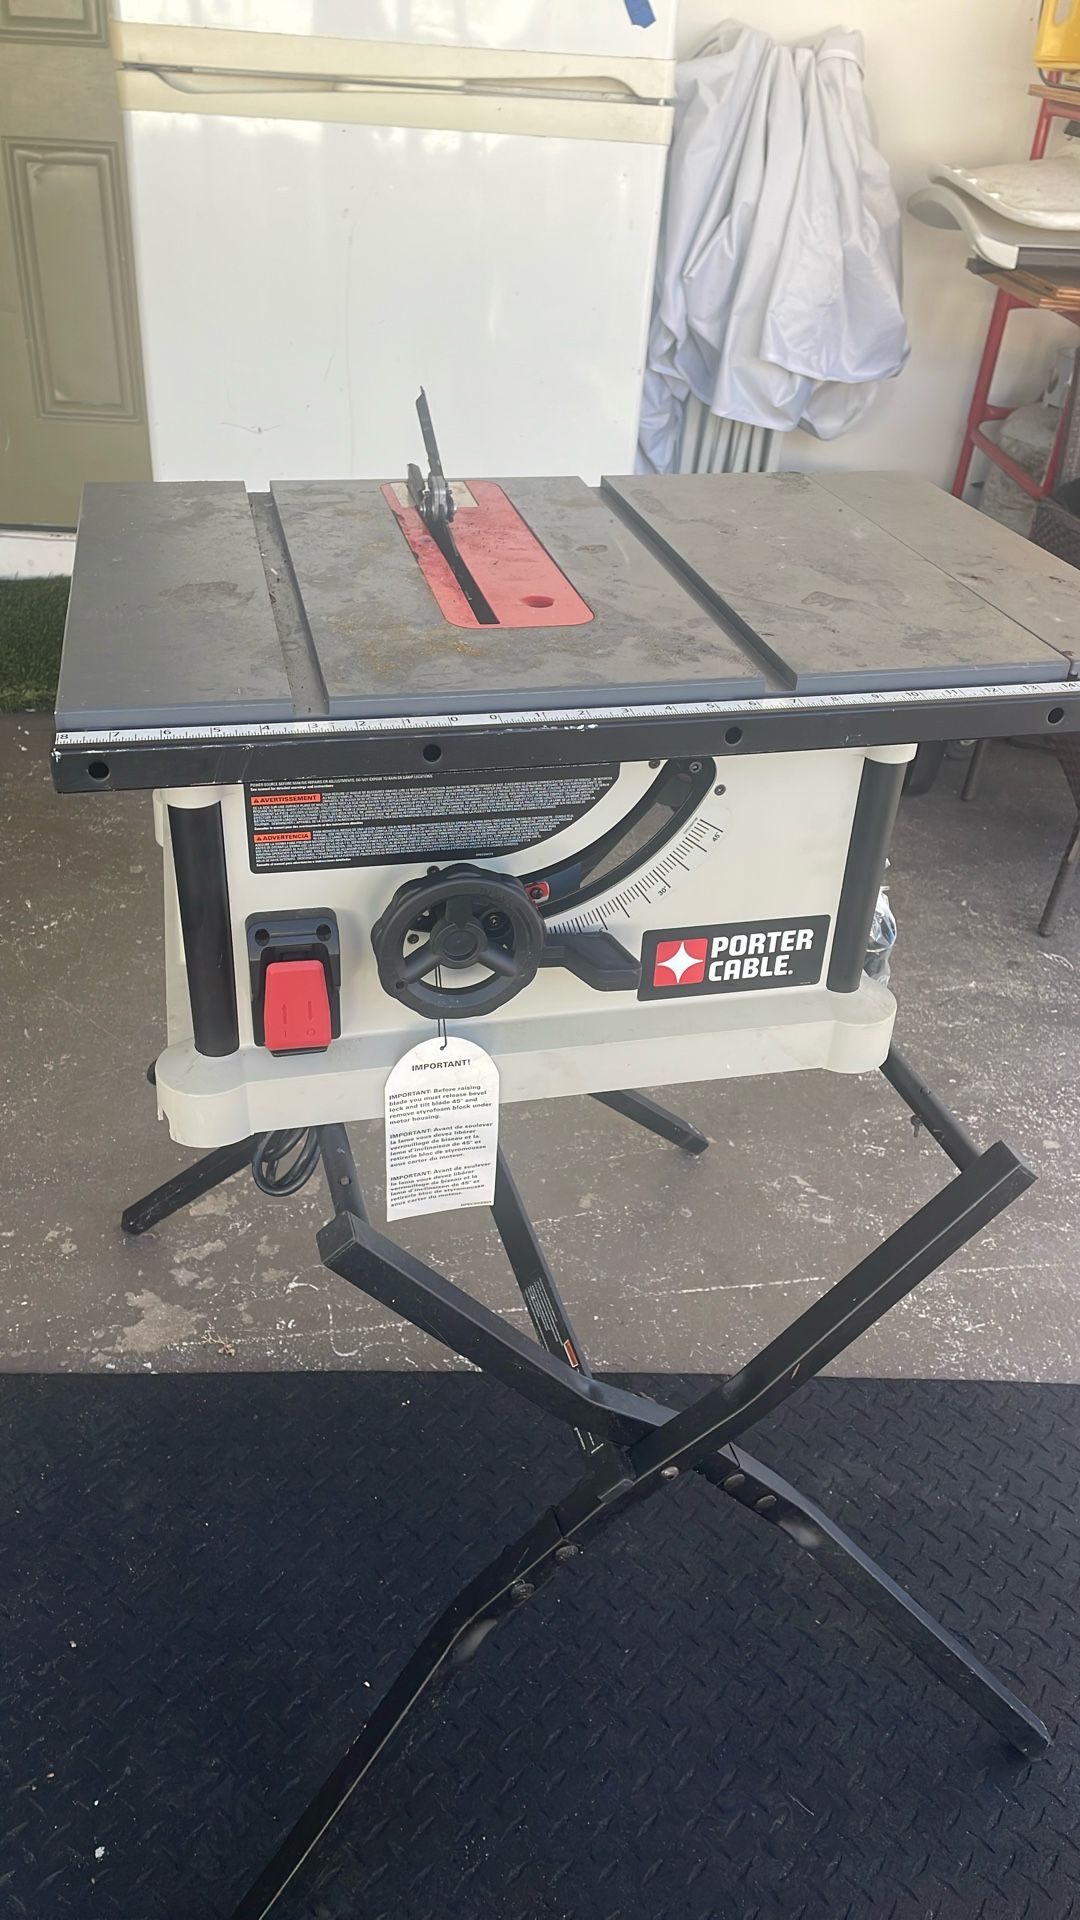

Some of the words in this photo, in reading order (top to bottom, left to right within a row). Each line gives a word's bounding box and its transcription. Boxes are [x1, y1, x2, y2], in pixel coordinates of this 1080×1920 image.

[658, 886, 667, 896] 30°
[711, 928, 814, 958] PORTER
[411, 1058, 470, 1071] IMPORTANT!
[389, 1090, 431, 1100] IMPORTANT:
[390, 1111, 414, 1119] remove
[416, 1107, 450, 1115] styrofoam
[412, 1114, 440, 1122] housing.
[390, 1129, 431, 1139] IMPORTANT:
[391, 1171, 431, 1181] IMPORTANT:
